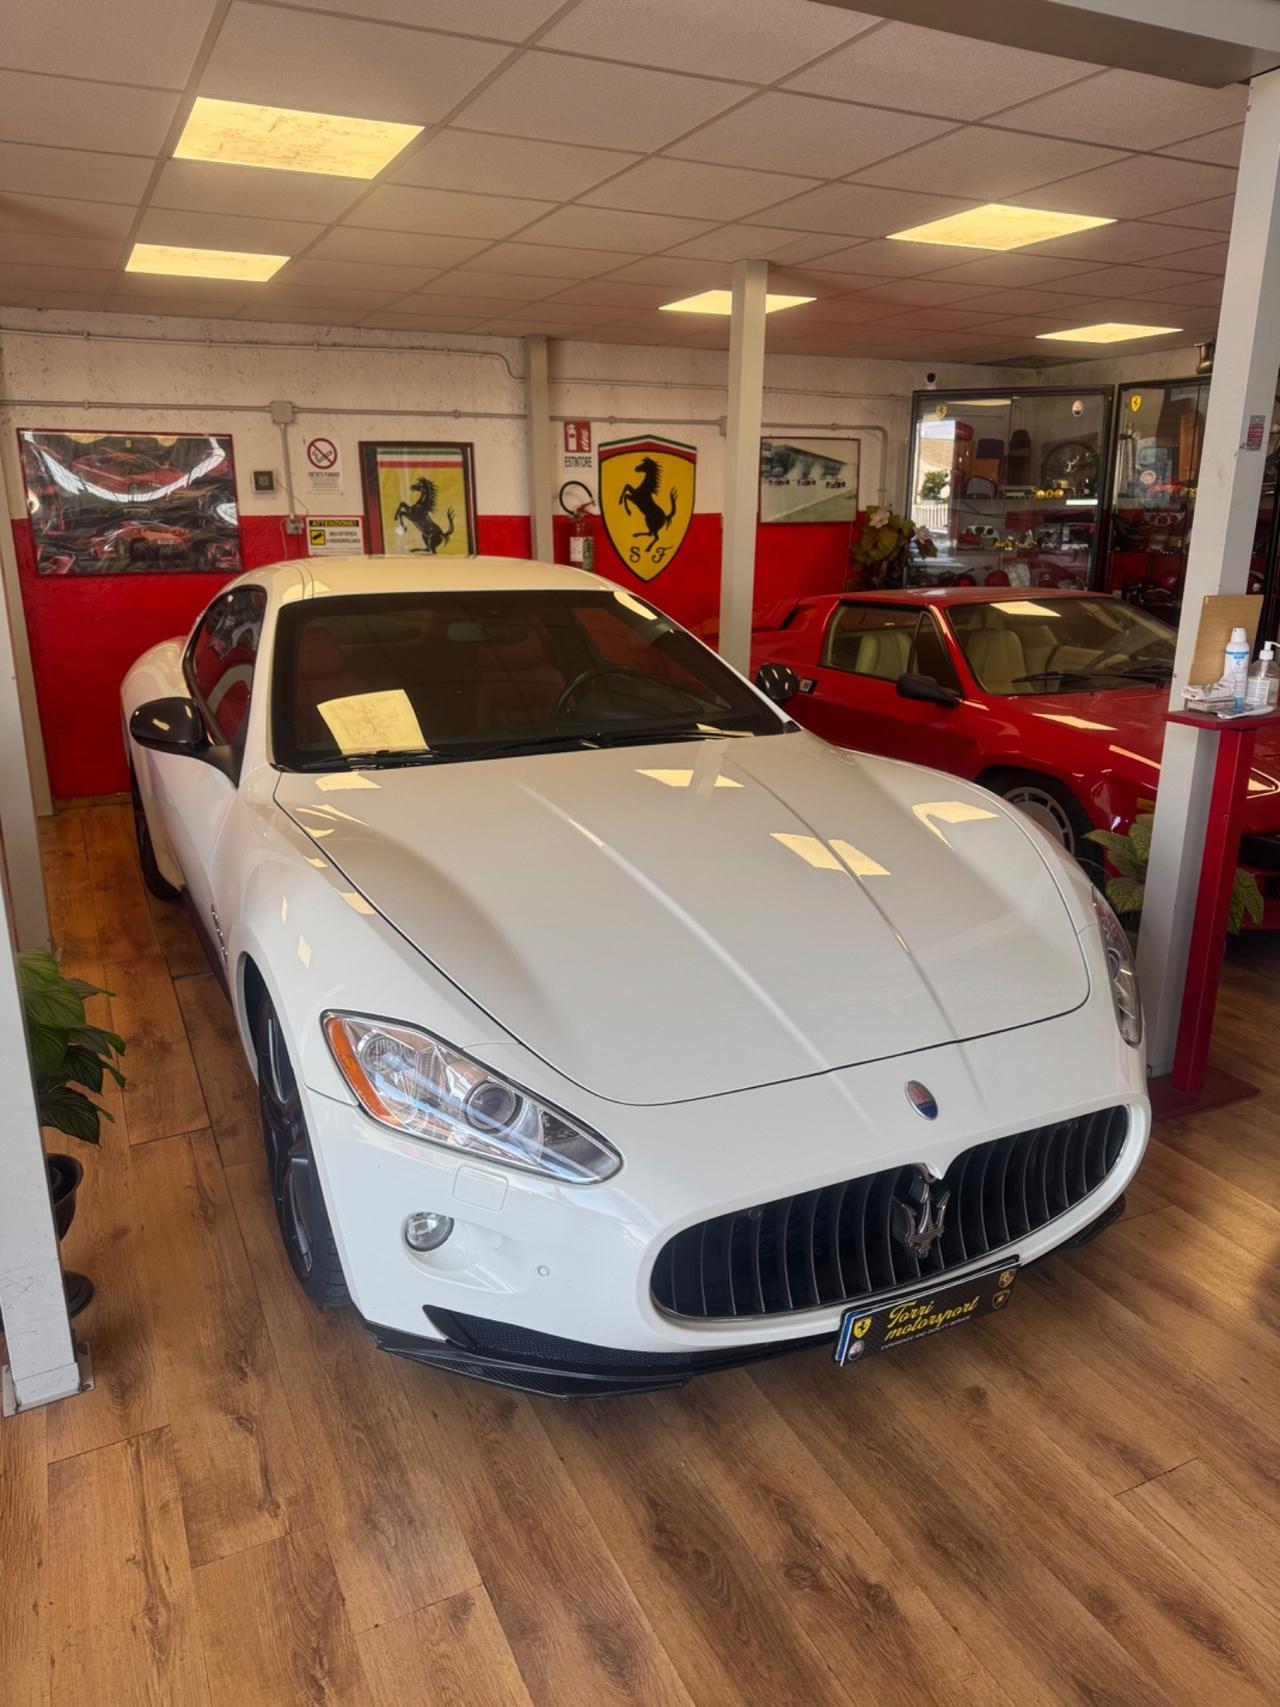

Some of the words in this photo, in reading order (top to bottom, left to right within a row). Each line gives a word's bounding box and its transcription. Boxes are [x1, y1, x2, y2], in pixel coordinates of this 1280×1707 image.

[629, 546, 641, 563] S
[651, 544, 674, 564] F
[884, 1295, 981, 1341] motorsport
